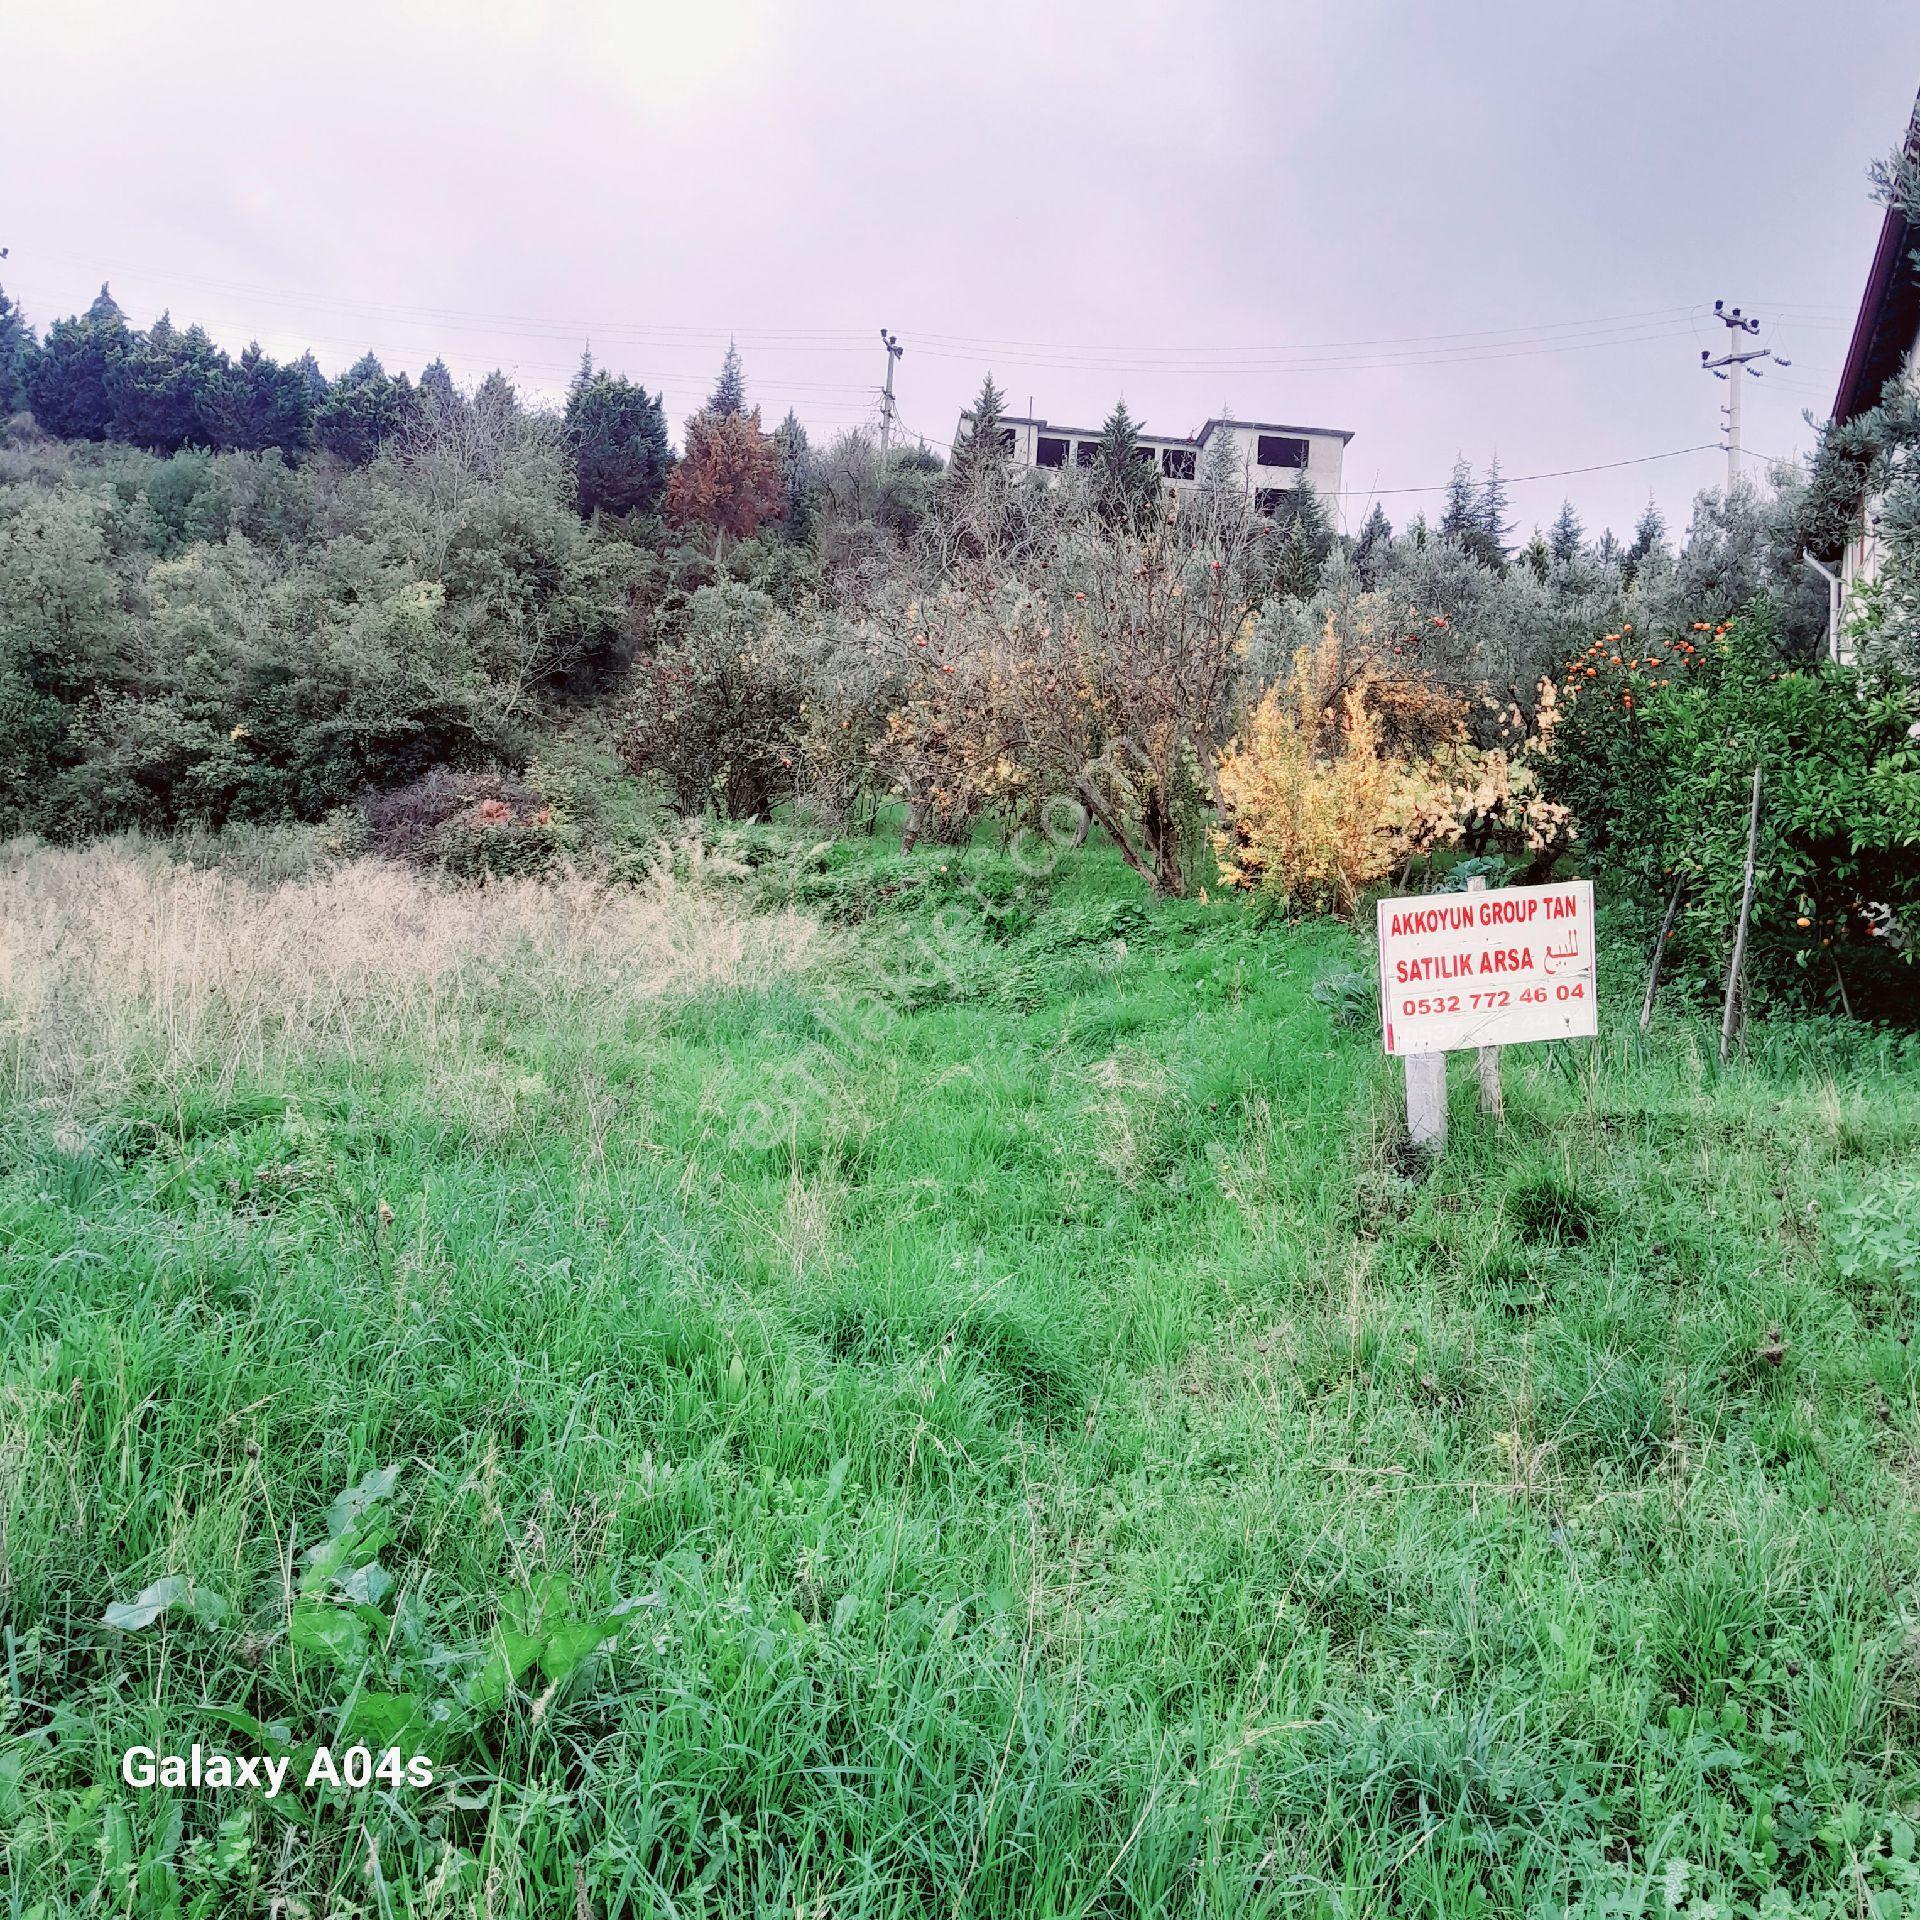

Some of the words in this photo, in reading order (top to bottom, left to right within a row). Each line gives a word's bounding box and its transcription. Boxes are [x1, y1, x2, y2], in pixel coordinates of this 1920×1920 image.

[1391, 906, 1474, 937] AKKOYUN
[1479, 899, 1537, 926] GROUP
[1543, 896, 1576, 920] TAN
[1396, 954, 1473, 983] SATILIK
[1480, 947, 1534, 974] ARSA
[1544, 929, 1578, 975] للبيع
[1403, 996, 1460, 1015] 0532
[1470, 991, 1509, 1008] 772
[1520, 989, 1547, 1003] 46
[1556, 983, 1583, 1000] 04
